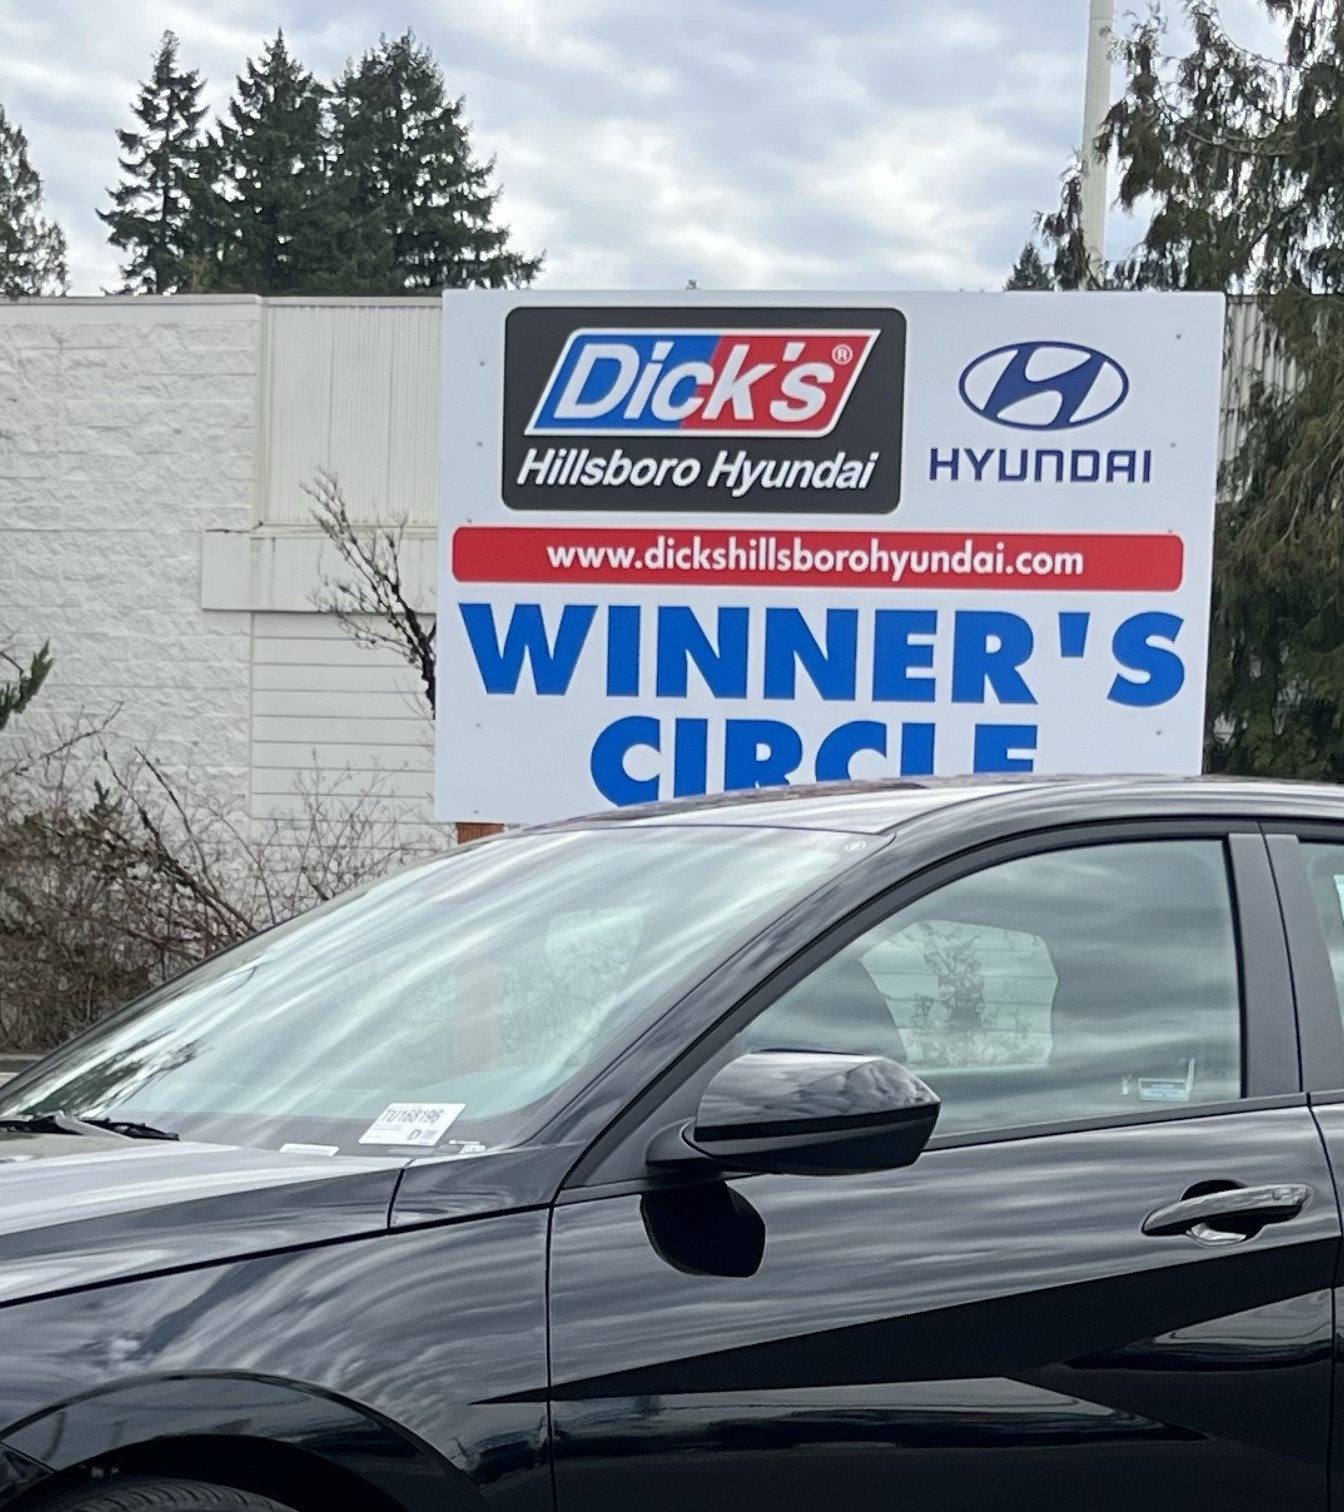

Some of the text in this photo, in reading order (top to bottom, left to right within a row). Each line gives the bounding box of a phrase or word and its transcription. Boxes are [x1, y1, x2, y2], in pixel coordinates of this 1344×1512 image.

[517, 448, 880, 498] Hillsboro Hyundai
[929, 447, 1151, 484] HYUNDAI
[545, 536, 1084, 583] www.dickshillsborohyundai.com
[458, 602, 1186, 708] WINNER'S
